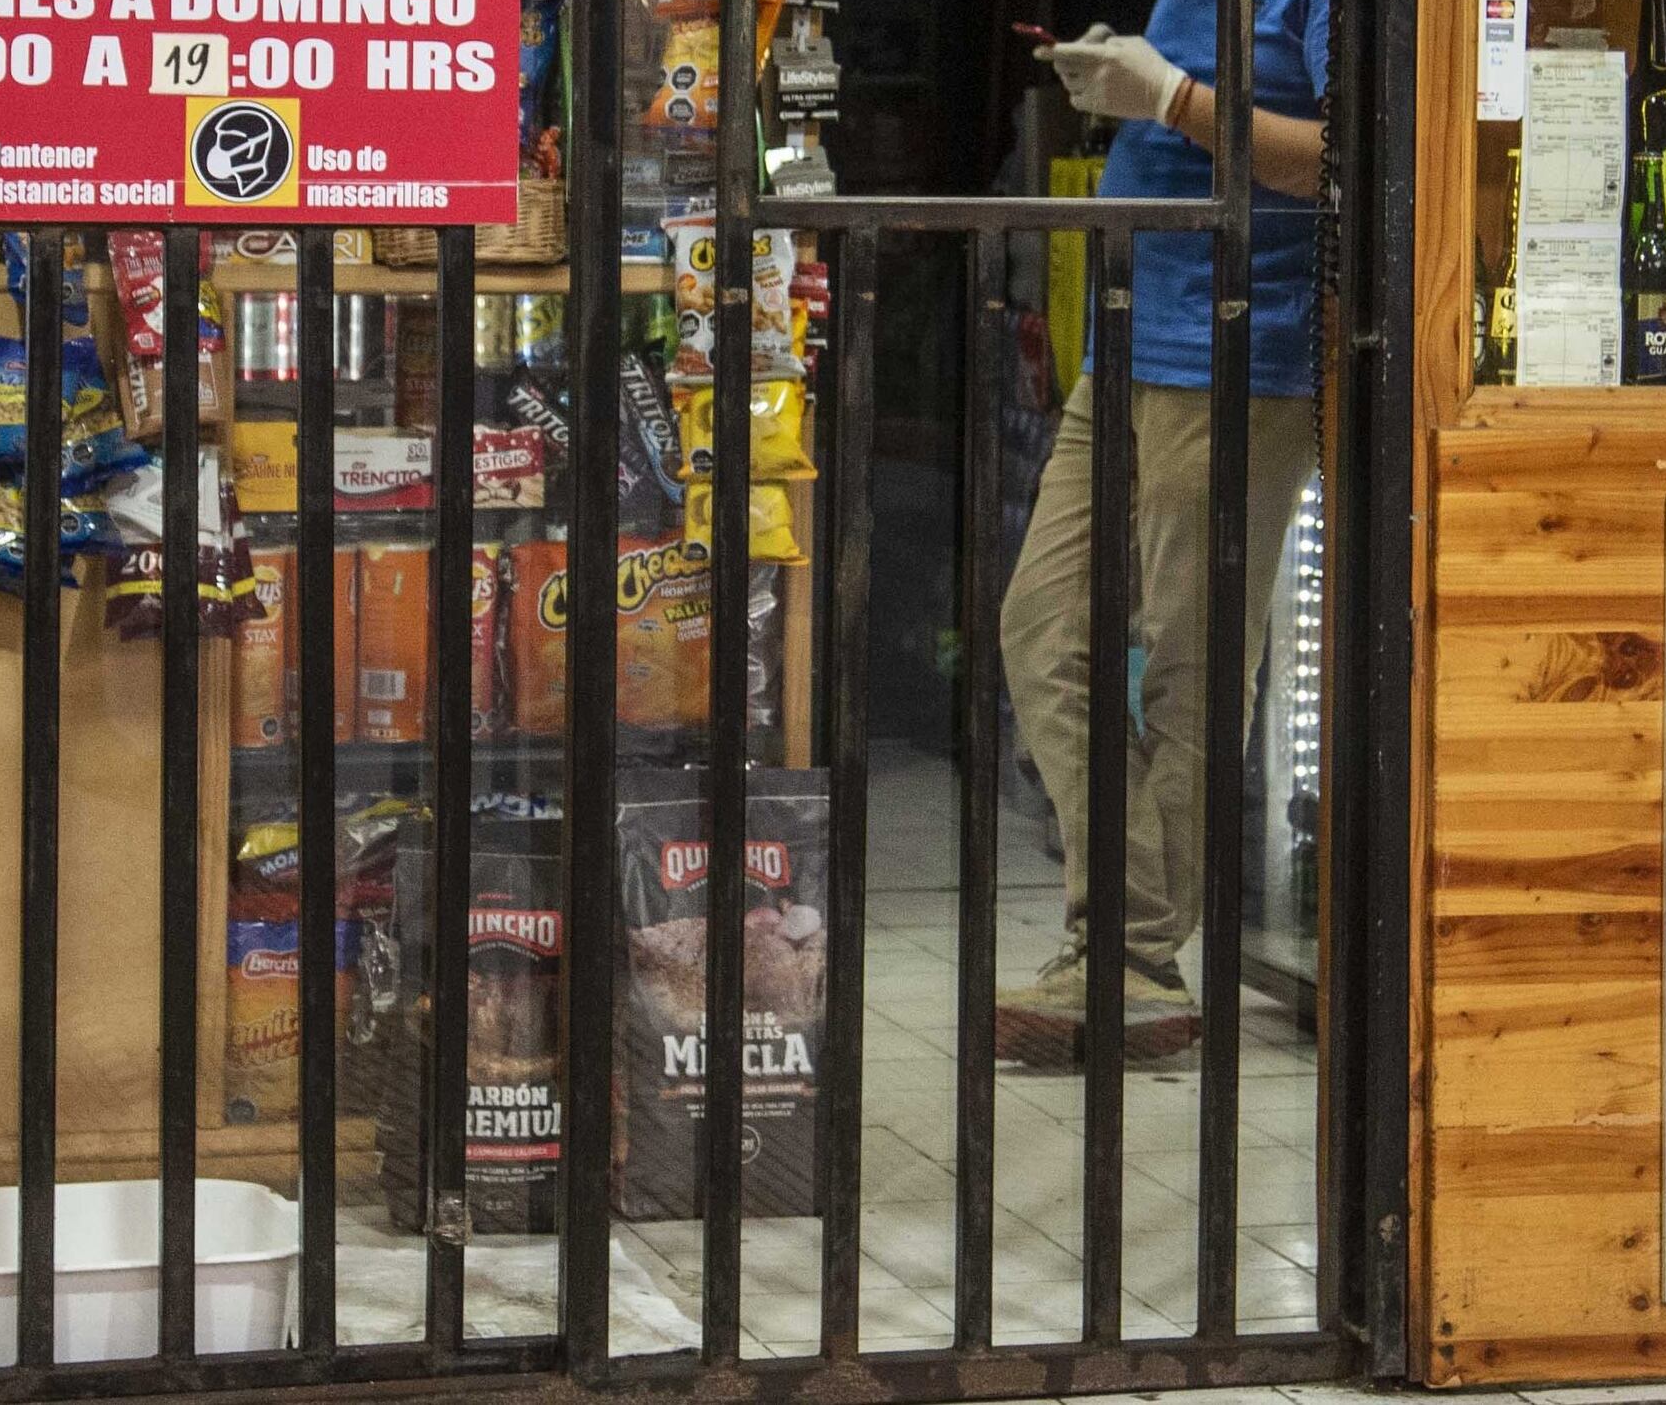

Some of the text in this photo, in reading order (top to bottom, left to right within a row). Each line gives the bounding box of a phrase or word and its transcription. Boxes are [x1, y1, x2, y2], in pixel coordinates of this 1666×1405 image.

[83, 35, 128, 88] A
[367, 39, 496, 93] HRS
[780, 71, 836, 87] LifeStyles
[307, 144, 387, 172] Uso de
[100, 179, 174, 207] social
[307, 180, 450, 209] mascarillas
[340, 470, 423, 487] TRENCITO
[244, 629, 277, 644] STAX
